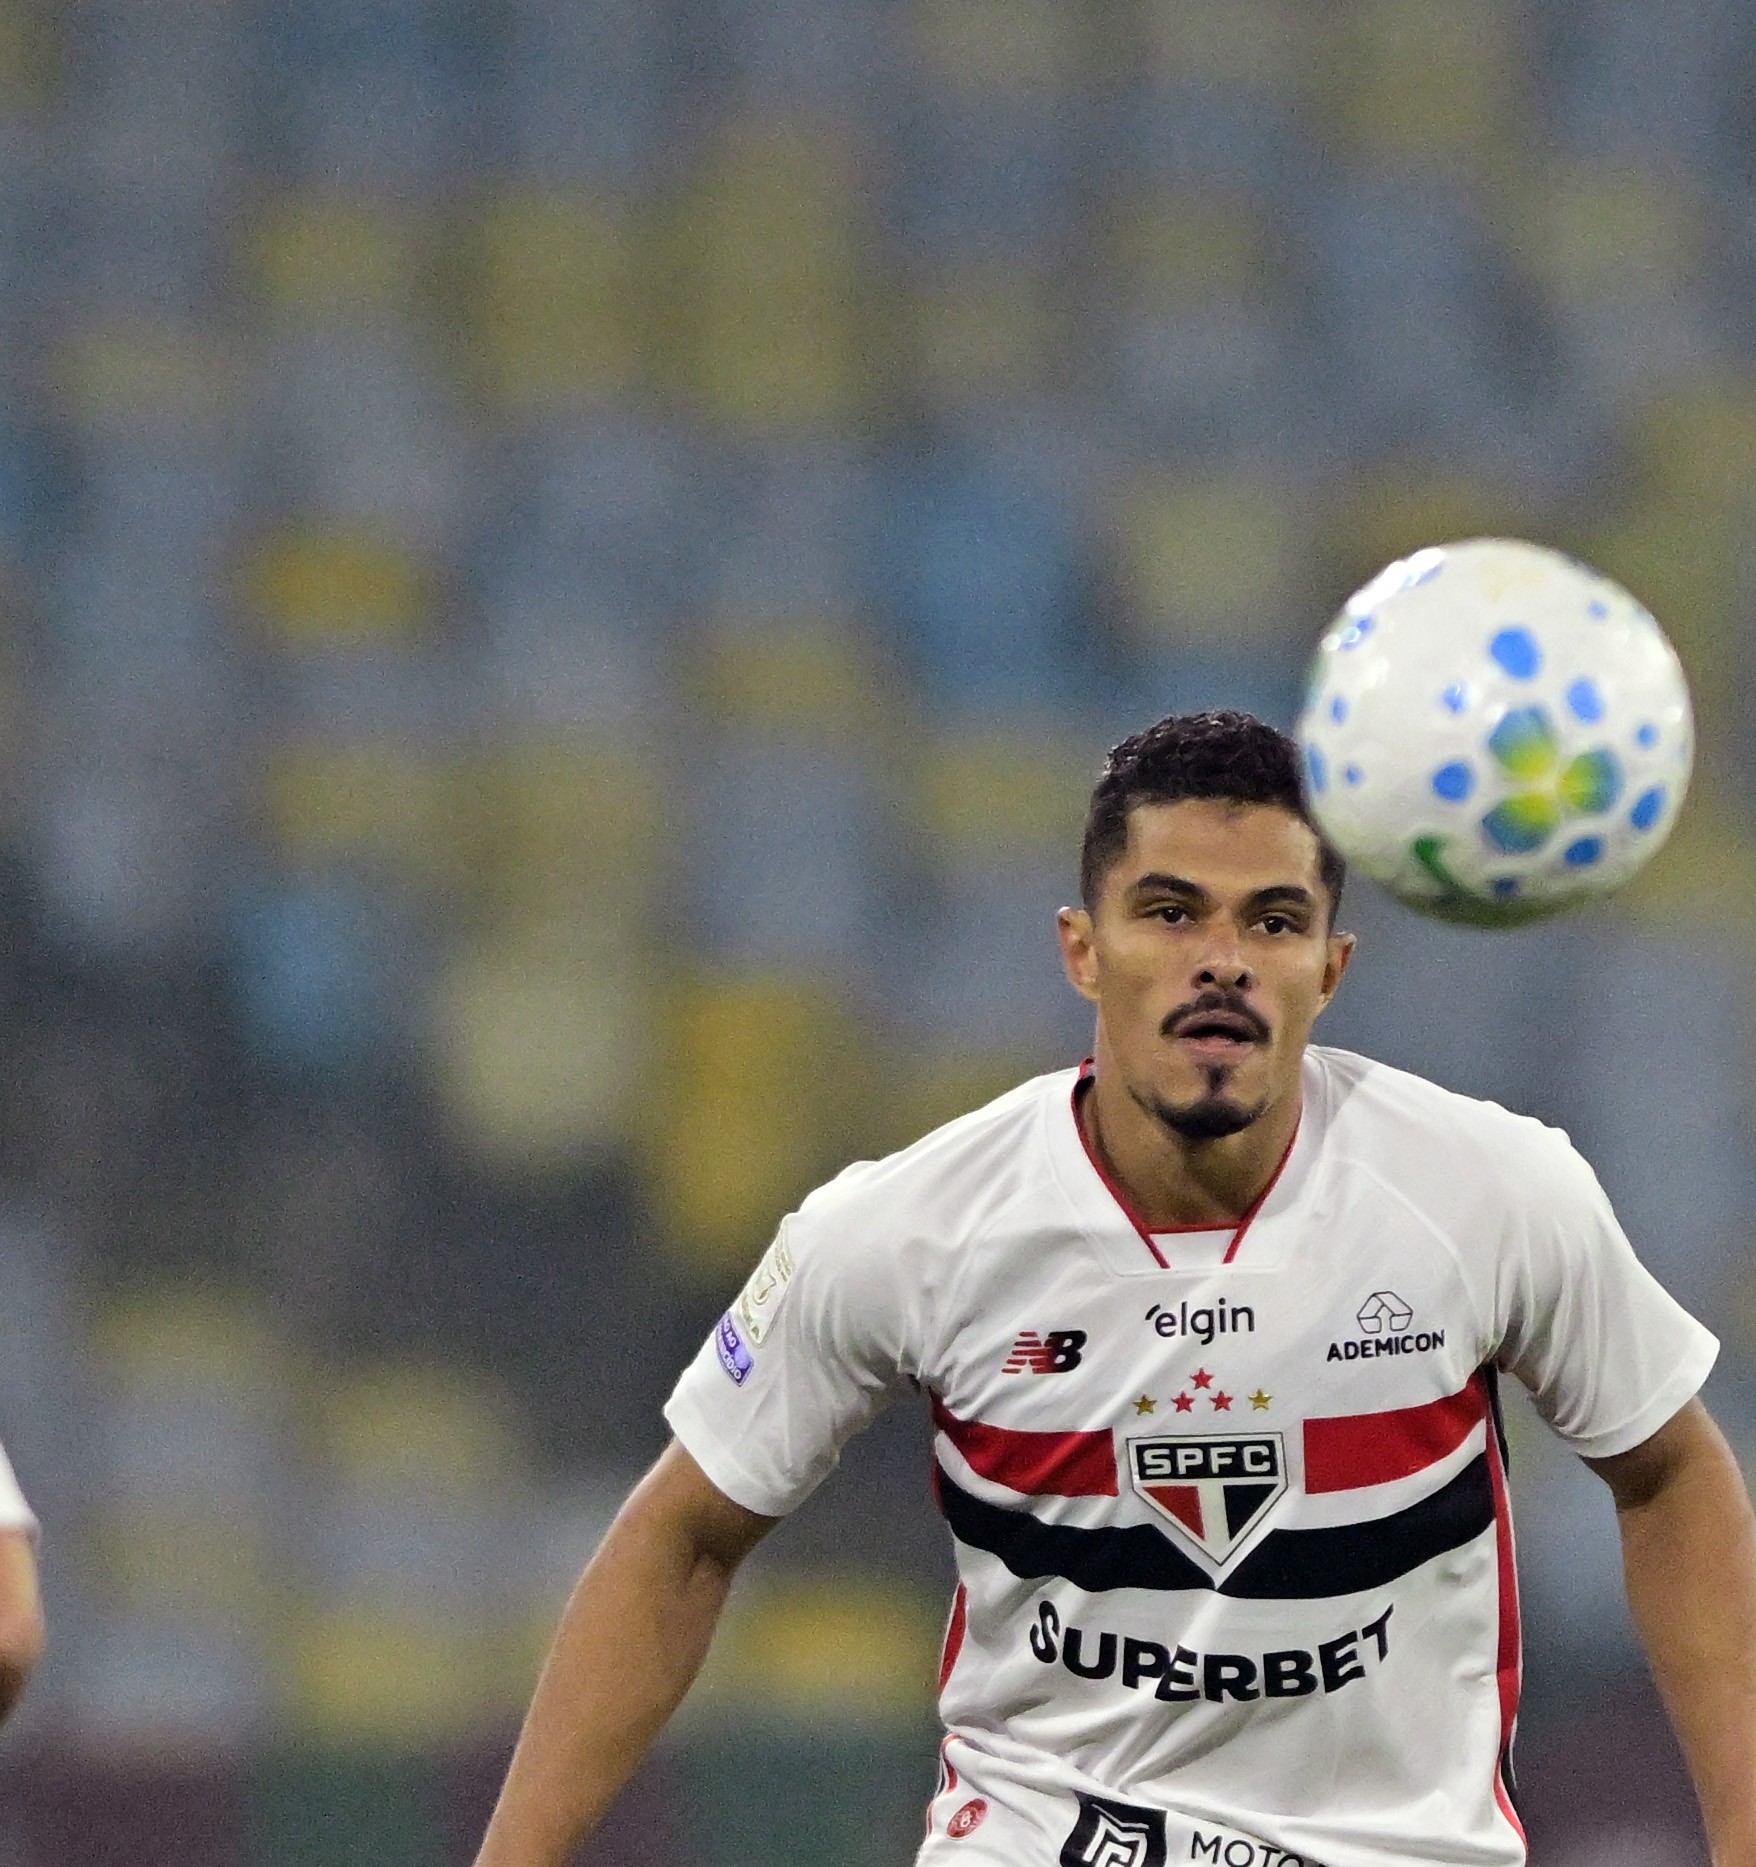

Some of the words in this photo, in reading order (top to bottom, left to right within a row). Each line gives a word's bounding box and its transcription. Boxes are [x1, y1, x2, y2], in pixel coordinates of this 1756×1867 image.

[1146, 1297, 1256, 1346] elgin
[1326, 1329, 1446, 1363] ADEMICON
[1142, 1444, 1273, 1477] SPFC
[1029, 1600, 1395, 1703] SUPERBET
